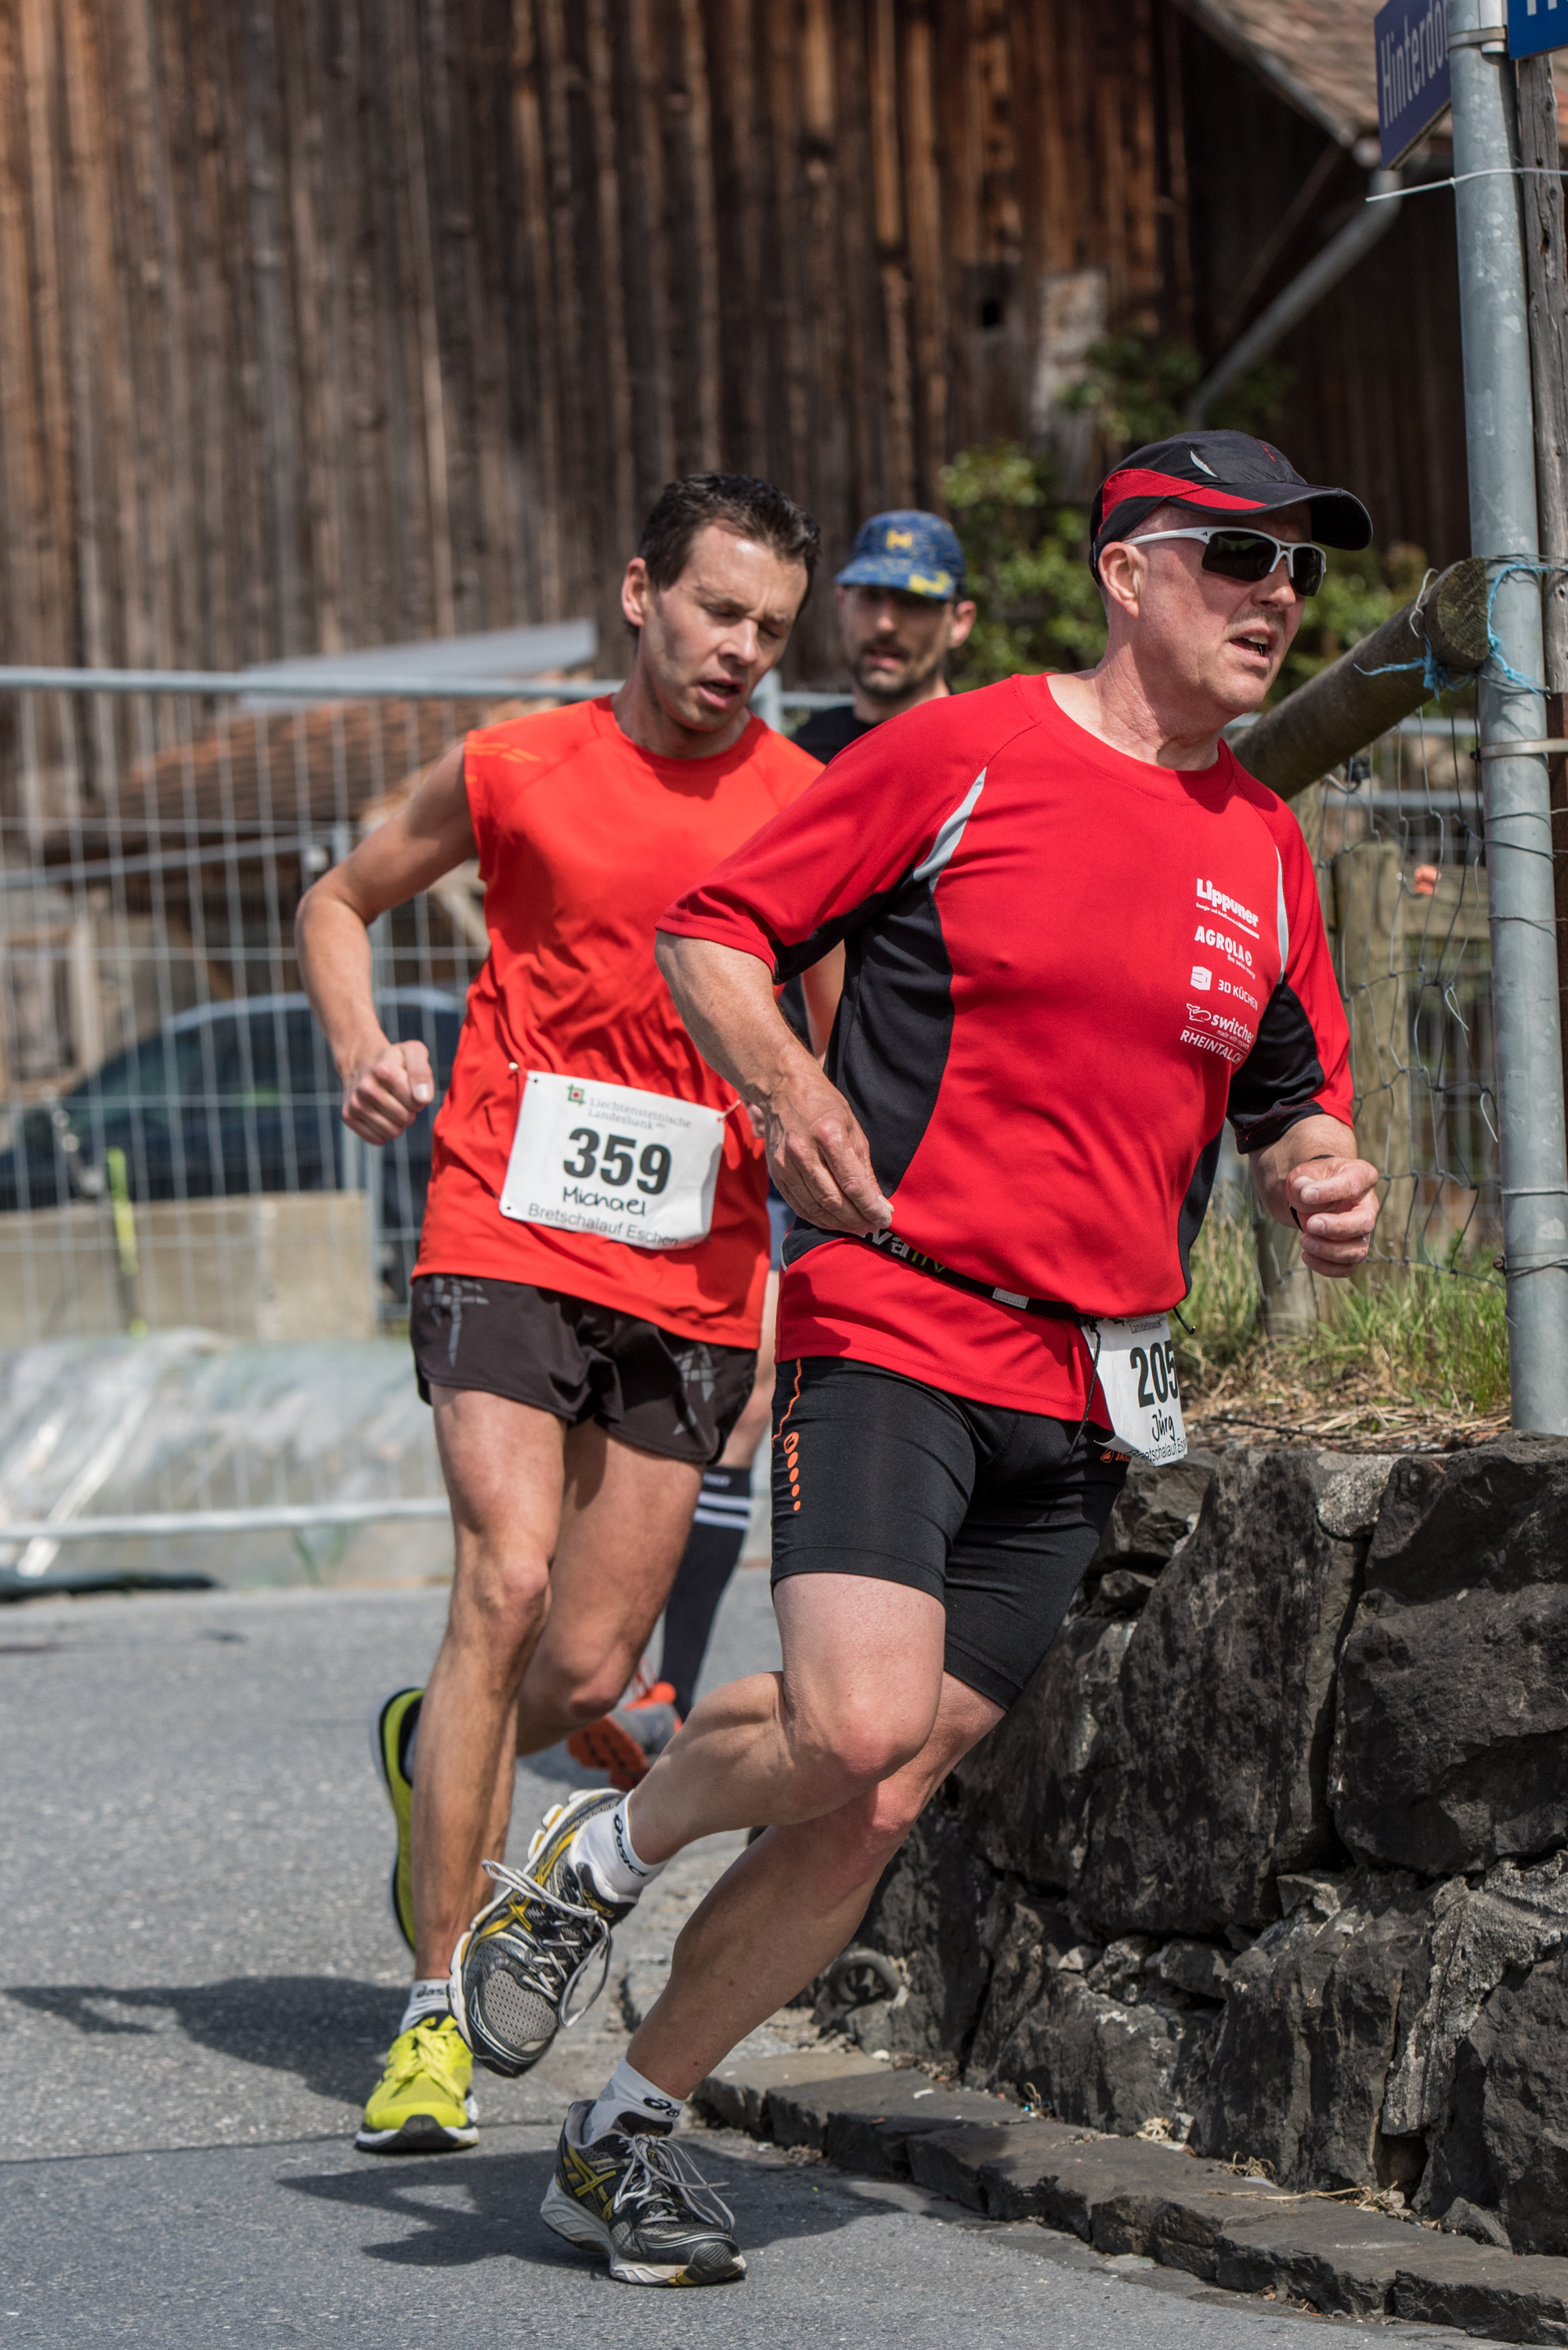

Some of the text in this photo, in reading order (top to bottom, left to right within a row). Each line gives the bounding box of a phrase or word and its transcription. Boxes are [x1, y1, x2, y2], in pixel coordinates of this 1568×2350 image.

[1197, 878, 1259, 927] Lippuner
[1194, 926, 1245, 962] AGROLA
[1218, 979, 1231, 993] 3D
[587, 1108, 653, 1130] Landesbank
[590, 1097, 692, 1129] Liechtensteinische
[563, 1128, 671, 1195] 359
[563, 1187, 646, 1216] Michael
[528, 1202, 679, 1248] Bretschalauf Eschen
[1129, 1340, 1178, 1408] 205
